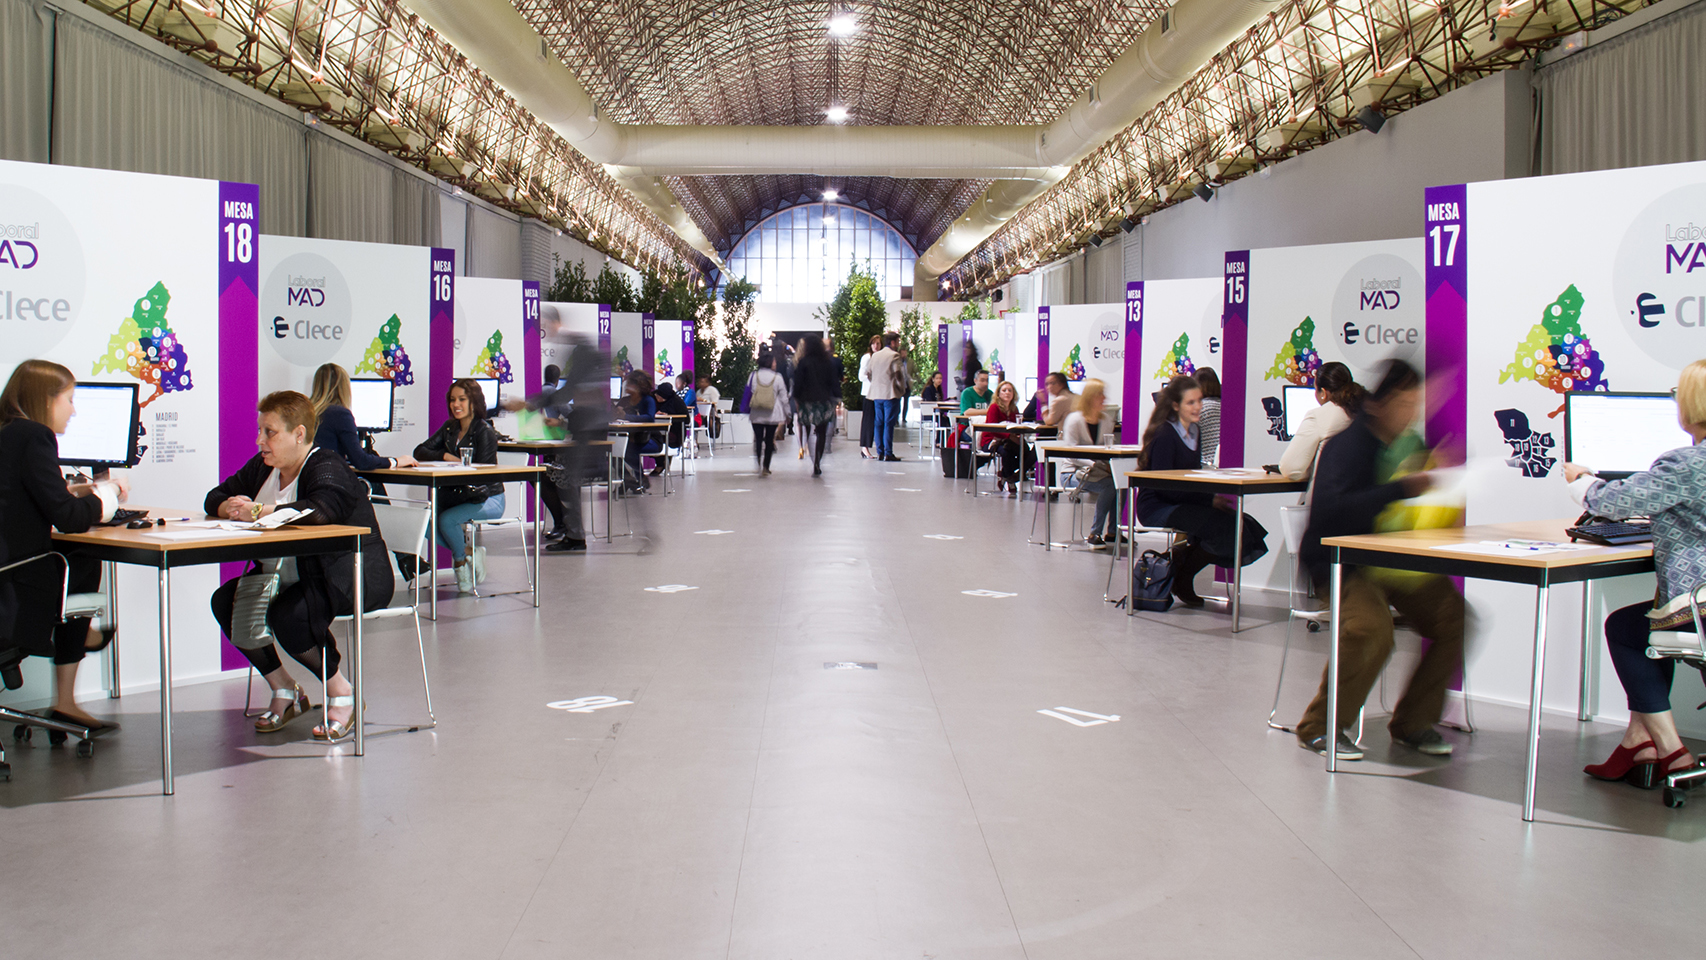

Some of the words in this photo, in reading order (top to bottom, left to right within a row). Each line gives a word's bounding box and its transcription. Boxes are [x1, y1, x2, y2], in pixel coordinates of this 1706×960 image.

[224, 200, 254, 220] MESA
[1428, 202, 1460, 221] MESA
[224, 222, 252, 263] 18
[1430, 224, 1460, 266] 17
[434, 260, 452, 272] MESA
[1226, 262, 1245, 274] MESA
[288, 274, 326, 288] Laboral
[434, 274, 450, 302] 16
[1227, 276, 1244, 304] 15
[1360, 276, 1401, 290] Laboral
[288, 287, 325, 307] MAD
[525, 288, 538, 298] MESA
[1128, 290, 1141, 299] MESA
[1360, 290, 1400, 310] MAD
[0, 290, 70, 322] lece
[525, 299, 538, 320] 14
[1128, 300, 1141, 322] 13
[294, 320, 343, 340] Clece
[600, 319, 610, 334] 12
[644, 326, 653, 340] 10
[1040, 320, 1048, 336] 11
[1100, 330, 1119, 341] MAD
[1364, 324, 1418, 345] Clece
[684, 331, 690, 344] 8
[941, 334, 946, 344] 5
[966, 331, 970, 342] 7
[156, 412, 178, 421] MADRID
[546, 695, 634, 713] 18
[1036, 706, 1121, 727] 17
